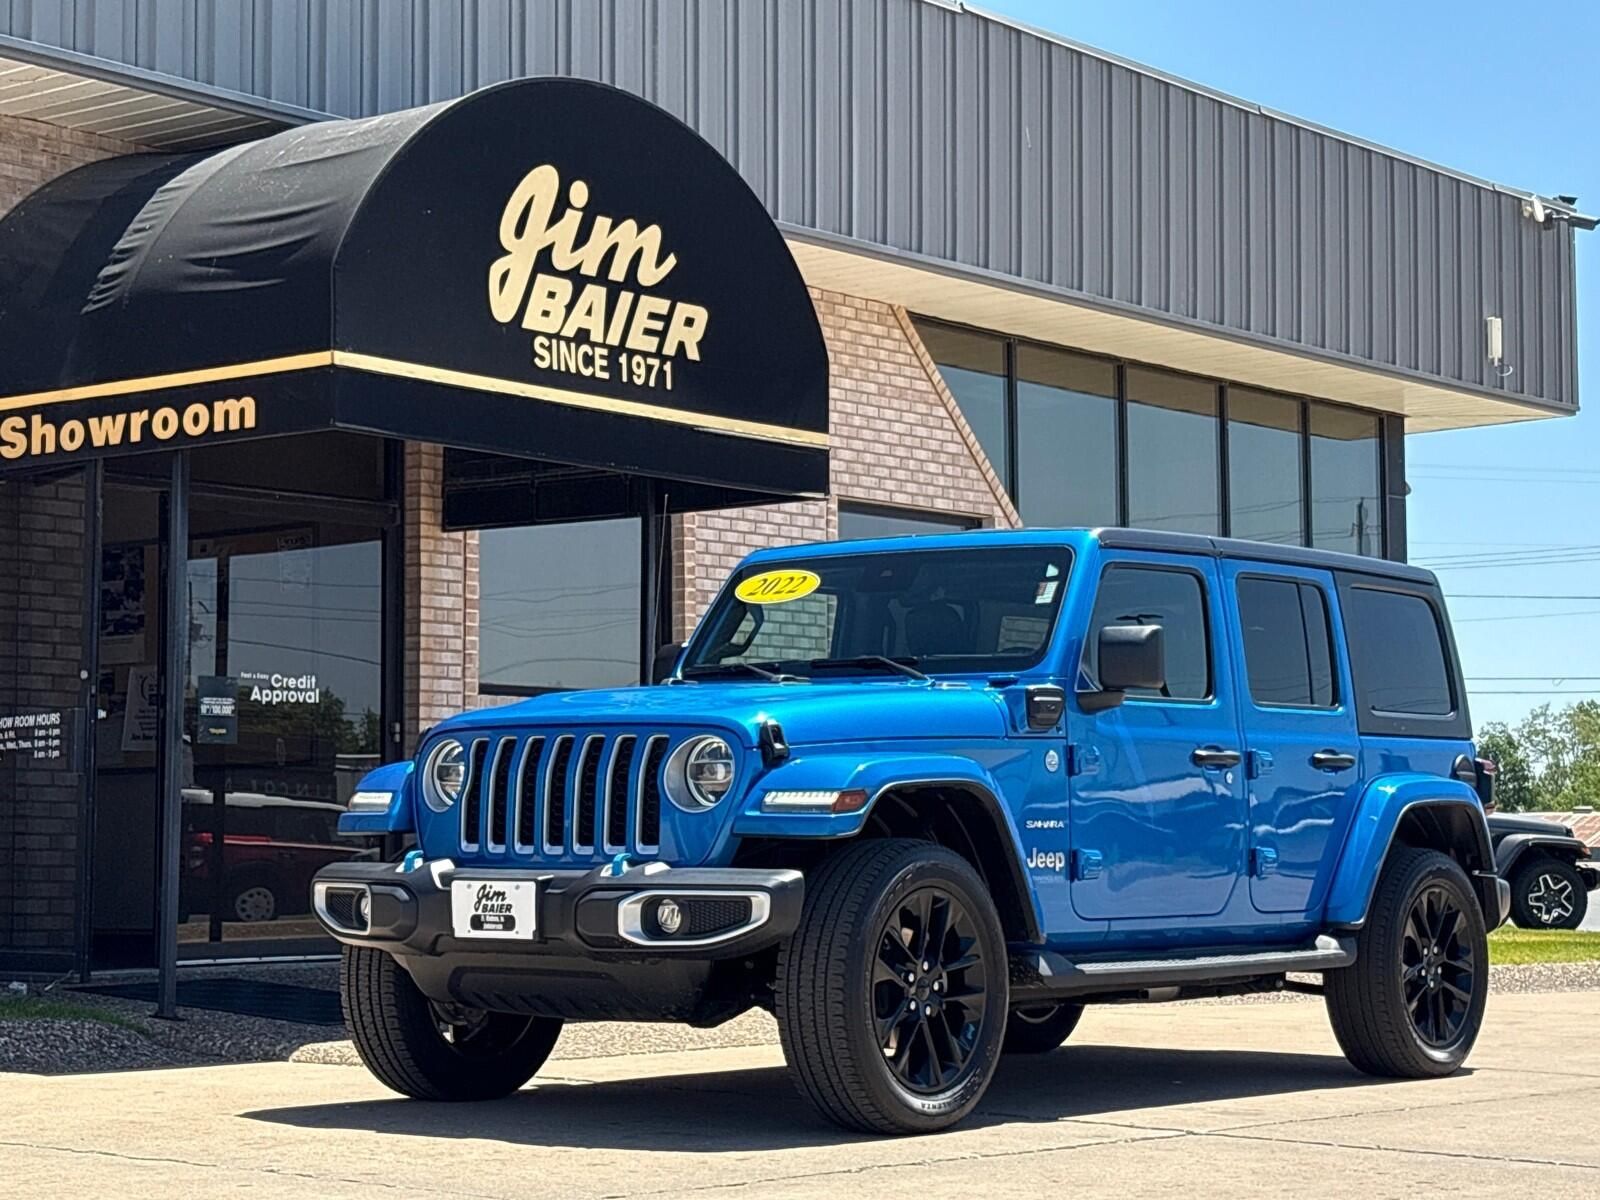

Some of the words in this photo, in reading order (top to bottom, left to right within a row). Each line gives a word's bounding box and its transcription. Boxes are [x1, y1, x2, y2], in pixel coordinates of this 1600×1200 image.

[489, 164, 677, 323] Jim
[521, 273, 708, 361] BAIER
[533, 336, 610, 379] SINCE
[618, 352, 672, 390] 1971
[0, 396, 256, 459] Showroom
[745, 575, 808, 597] 2022
[271, 673, 316, 689] Credit
[250, 685, 320, 705] Approval
[14, 715, 35, 727] ROOM
[37, 712, 60, 726] HOURS
[1025, 820, 1065, 829] SAHARA
[1026, 847, 1065, 872] Jeep
[473, 883, 507, 912] Jim
[482, 904, 512, 913] BAIER
